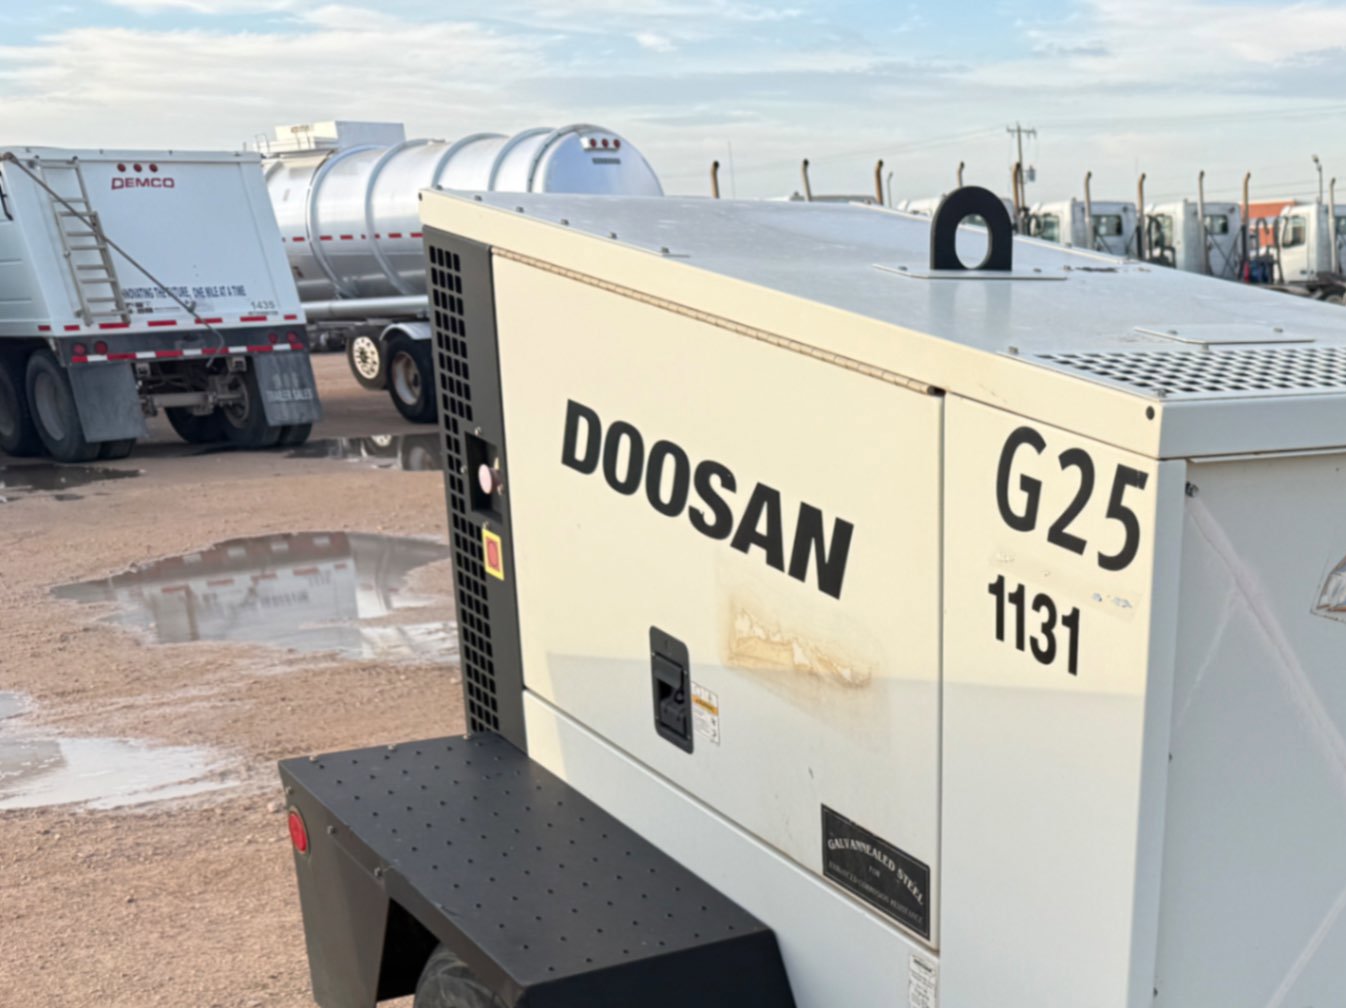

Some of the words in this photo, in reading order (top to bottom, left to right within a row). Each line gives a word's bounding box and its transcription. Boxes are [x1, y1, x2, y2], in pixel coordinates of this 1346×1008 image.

[111, 177, 175, 190] DEMCO
[561, 398, 854, 601] DOOSAN
[996, 426, 1149, 571] G25
[988, 573, 1081, 677] 1131
[896, 868, 924, 905] STEEL
